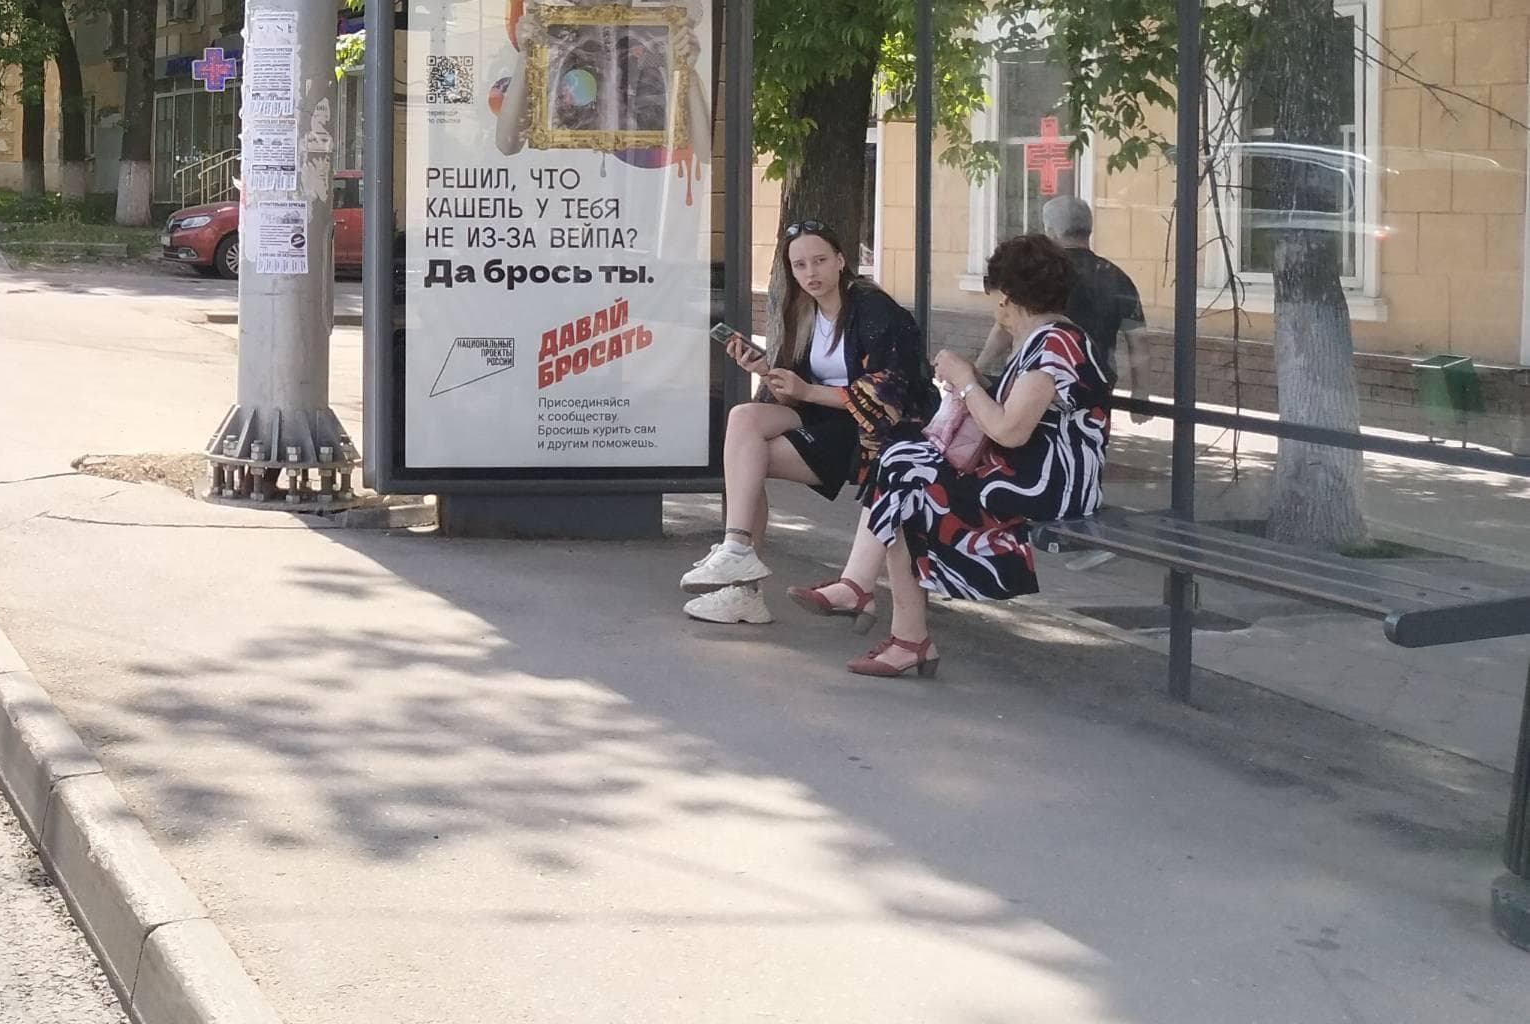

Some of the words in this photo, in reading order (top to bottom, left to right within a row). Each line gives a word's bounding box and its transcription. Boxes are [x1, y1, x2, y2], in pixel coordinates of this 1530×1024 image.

[426, 167, 517, 192] РЕШИЛ,
[530, 167, 581, 190] ЧТО
[426, 197, 523, 219] КАШЕЛЬ
[536, 197, 550, 219] У
[425, 226, 454, 248] НЕ
[468, 226, 536, 248] ИЗ-ЗА
[550, 222, 638, 249] ВЕЙПА?
[424, 259, 477, 288] Да
[483, 258, 593, 290] брось
[598, 265, 655, 284] ты.
[538, 296, 628, 363] ДАВАЙ
[538, 324, 653, 390] БРОСАТЬ
[538, 397, 630, 409] Присоединяйся
[538, 413, 545, 421] к
[538, 425, 590, 437] Бросишь
[592, 426, 631, 437] курить
[633, 425, 657, 434] сам
[537, 440, 544, 449] и
[547, 440, 589, 451] другим
[591, 439, 658, 449] поможешь.
